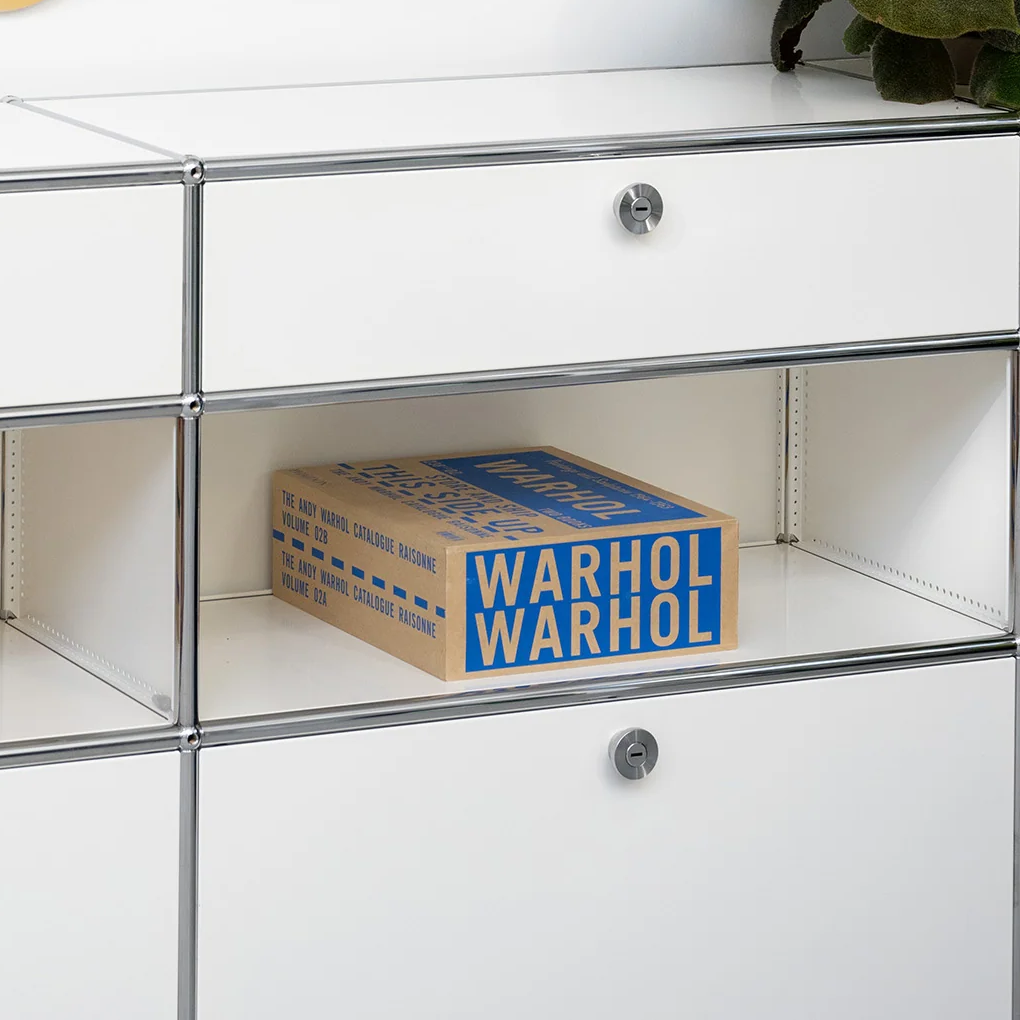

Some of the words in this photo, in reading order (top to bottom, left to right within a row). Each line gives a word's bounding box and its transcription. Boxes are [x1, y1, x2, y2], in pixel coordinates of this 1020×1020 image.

[362, 463, 437, 489] THIS
[424, 491, 502, 516] SIDE
[488, 519, 544, 534] UP
[425, 474, 476, 492] STORE
[496, 504, 539, 517] SHIP
[474, 459, 641, 520] WARHOL
[282, 511, 309, 536] VOLUME
[315, 526, 328, 545] 02B
[282, 490, 295, 509] THE
[299, 498, 316, 518] ANDY
[320, 508, 349, 534] WARHOL
[354, 523, 394, 554] CATALOGUE
[399, 543, 437, 574] RAISONNE
[282, 571, 309, 598] VOLUME
[314, 587, 327, 607] 02A
[282, 551, 294, 570] THE
[298, 559, 316, 580] ANDY
[320, 569, 349, 596] WARHOL
[354, 585, 394, 618] CATALOGUE
[399, 607, 436, 639] RAISONNE
[474, 534, 713, 609] WARHOL
[474, 590, 713, 666] WARHOL
